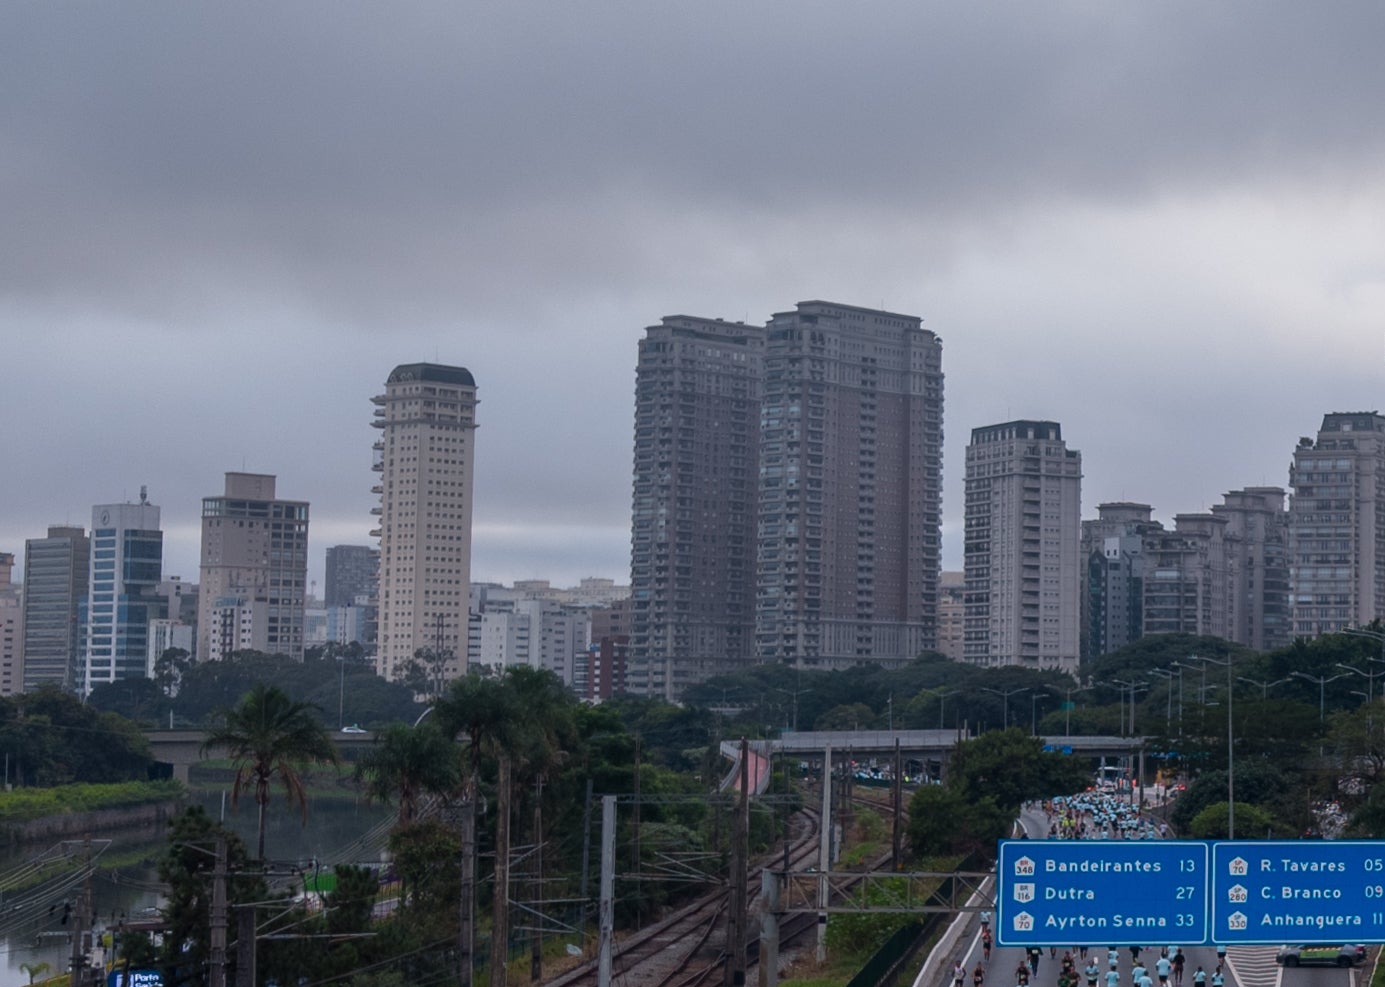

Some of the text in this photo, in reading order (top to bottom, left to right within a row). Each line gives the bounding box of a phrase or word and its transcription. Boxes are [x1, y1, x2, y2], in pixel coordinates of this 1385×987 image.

[1016, 866, 1033, 874] 348
[1045, 859, 1195, 872] Bandeirantes 13
[1233, 866, 1244, 874] 70
[1261, 858, 1383, 872] R. Tavares 05
[1017, 892, 1030, 900] 116
[1045, 887, 1195, 900] Dutra 27
[1261, 885, 1383, 899] C. Branco 09
[1018, 921, 1030, 930] 70
[1045, 914, 1194, 930] Ayrton Senna 33
[1229, 920, 1246, 928] 330
[1260, 912, 1383, 929] Anhanguera 11
[134, 973, 159, 982] Porto
